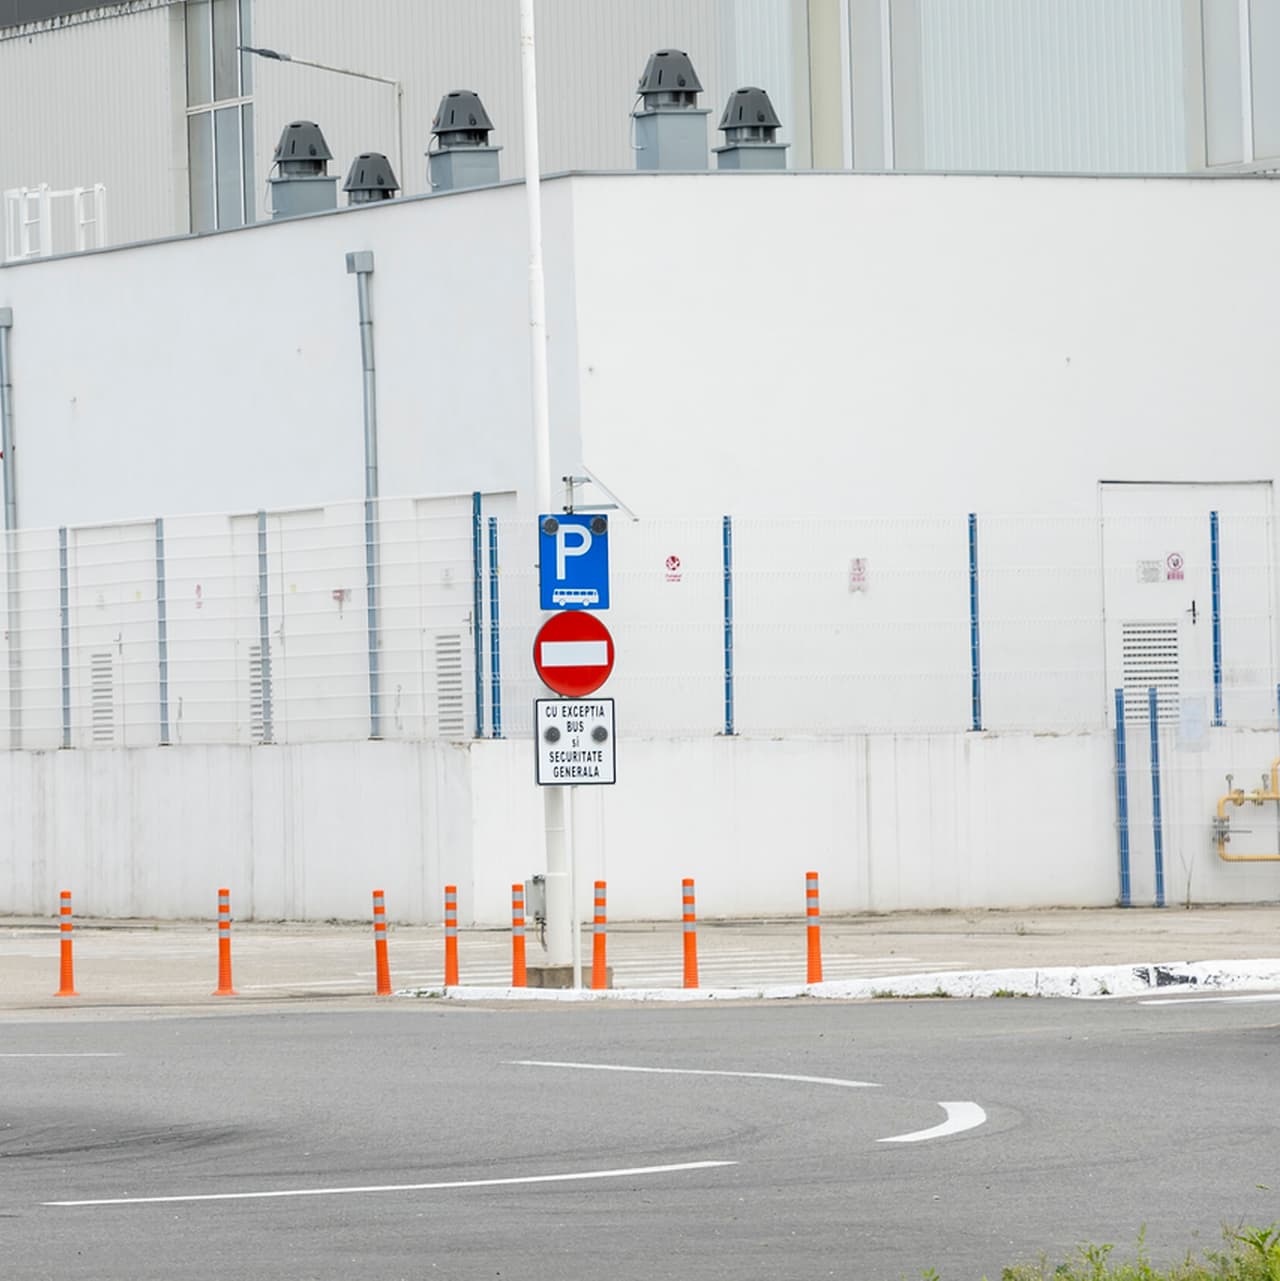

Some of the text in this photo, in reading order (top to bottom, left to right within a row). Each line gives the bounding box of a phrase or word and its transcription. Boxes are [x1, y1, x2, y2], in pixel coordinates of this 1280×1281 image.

[556, 524, 592, 580] P
[545, 705, 558, 719] CU
[566, 720, 585, 733] BUS
[548, 750, 603, 764] SECURITATE
